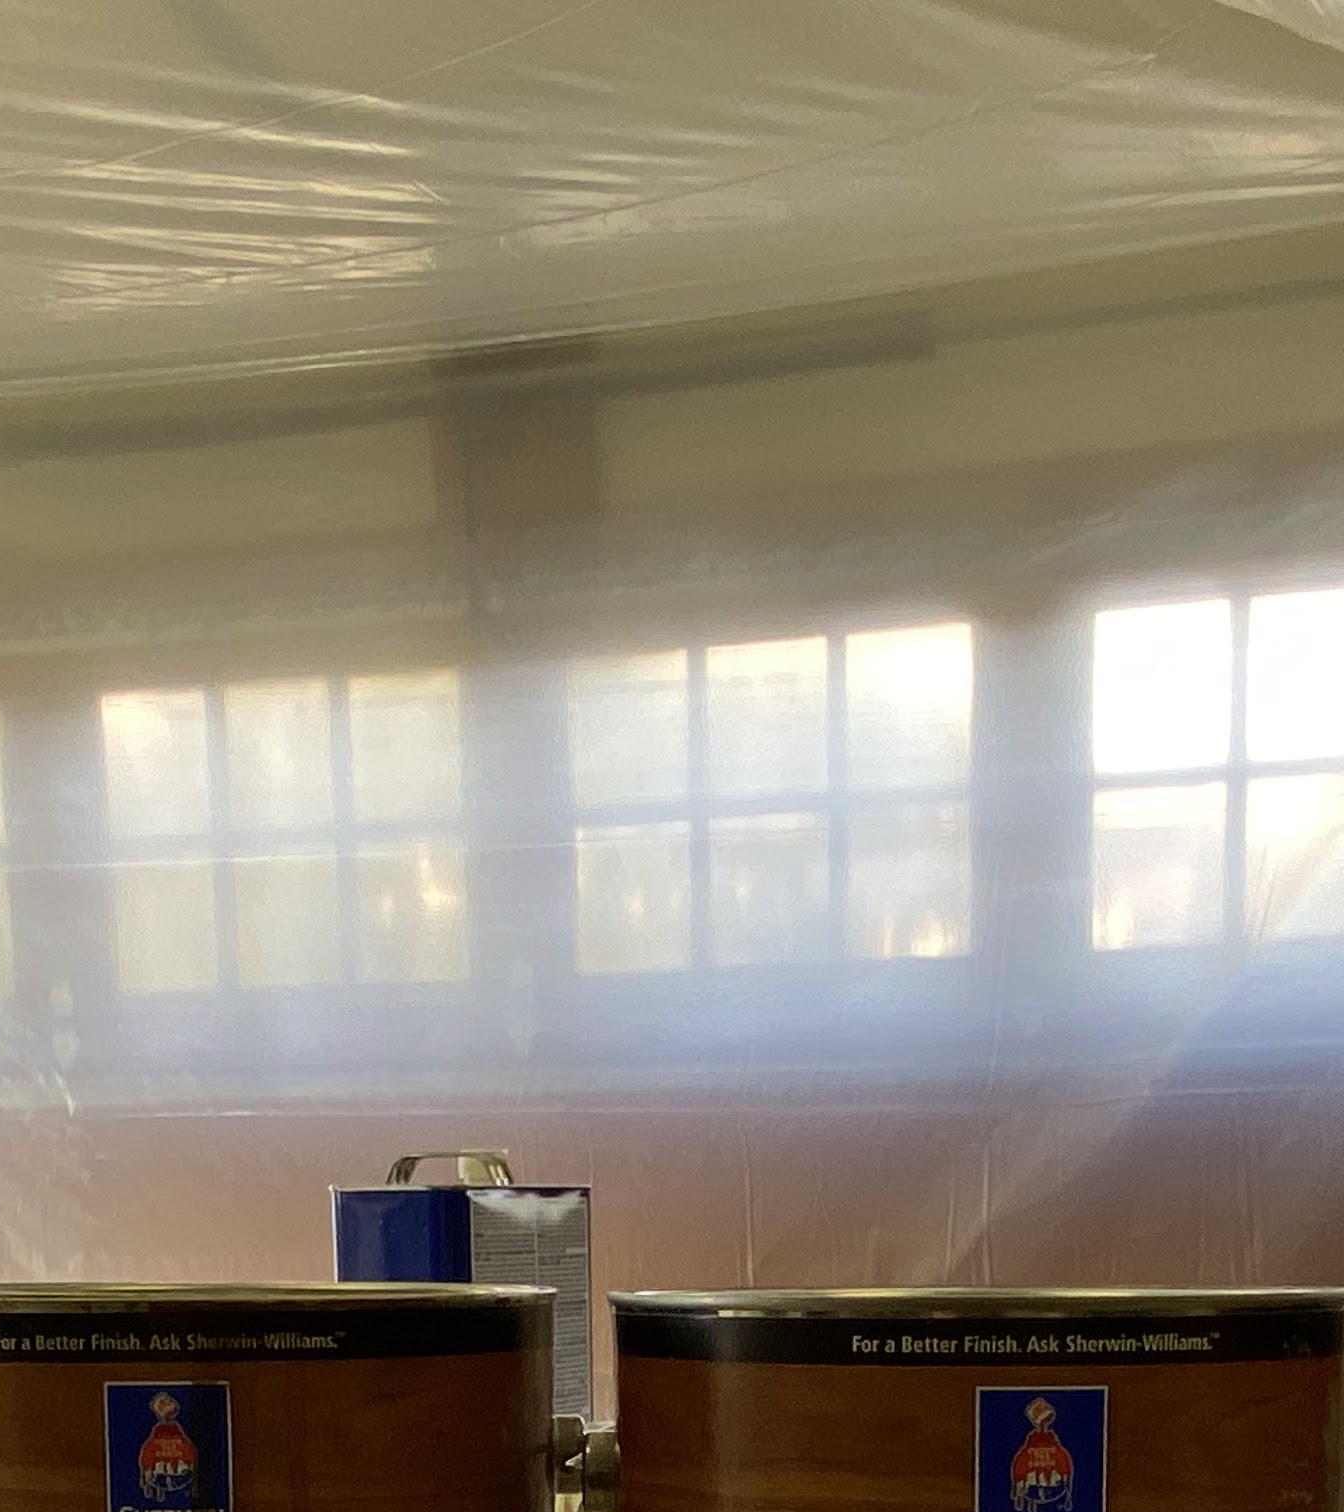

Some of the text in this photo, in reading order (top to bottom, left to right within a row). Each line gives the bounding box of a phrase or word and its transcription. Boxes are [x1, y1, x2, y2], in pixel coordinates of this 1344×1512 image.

[36, 1334, 86, 1351] Better
[150, 1333, 181, 1351] Ask
[852, 1335, 1059, 1352] For Better Ask
